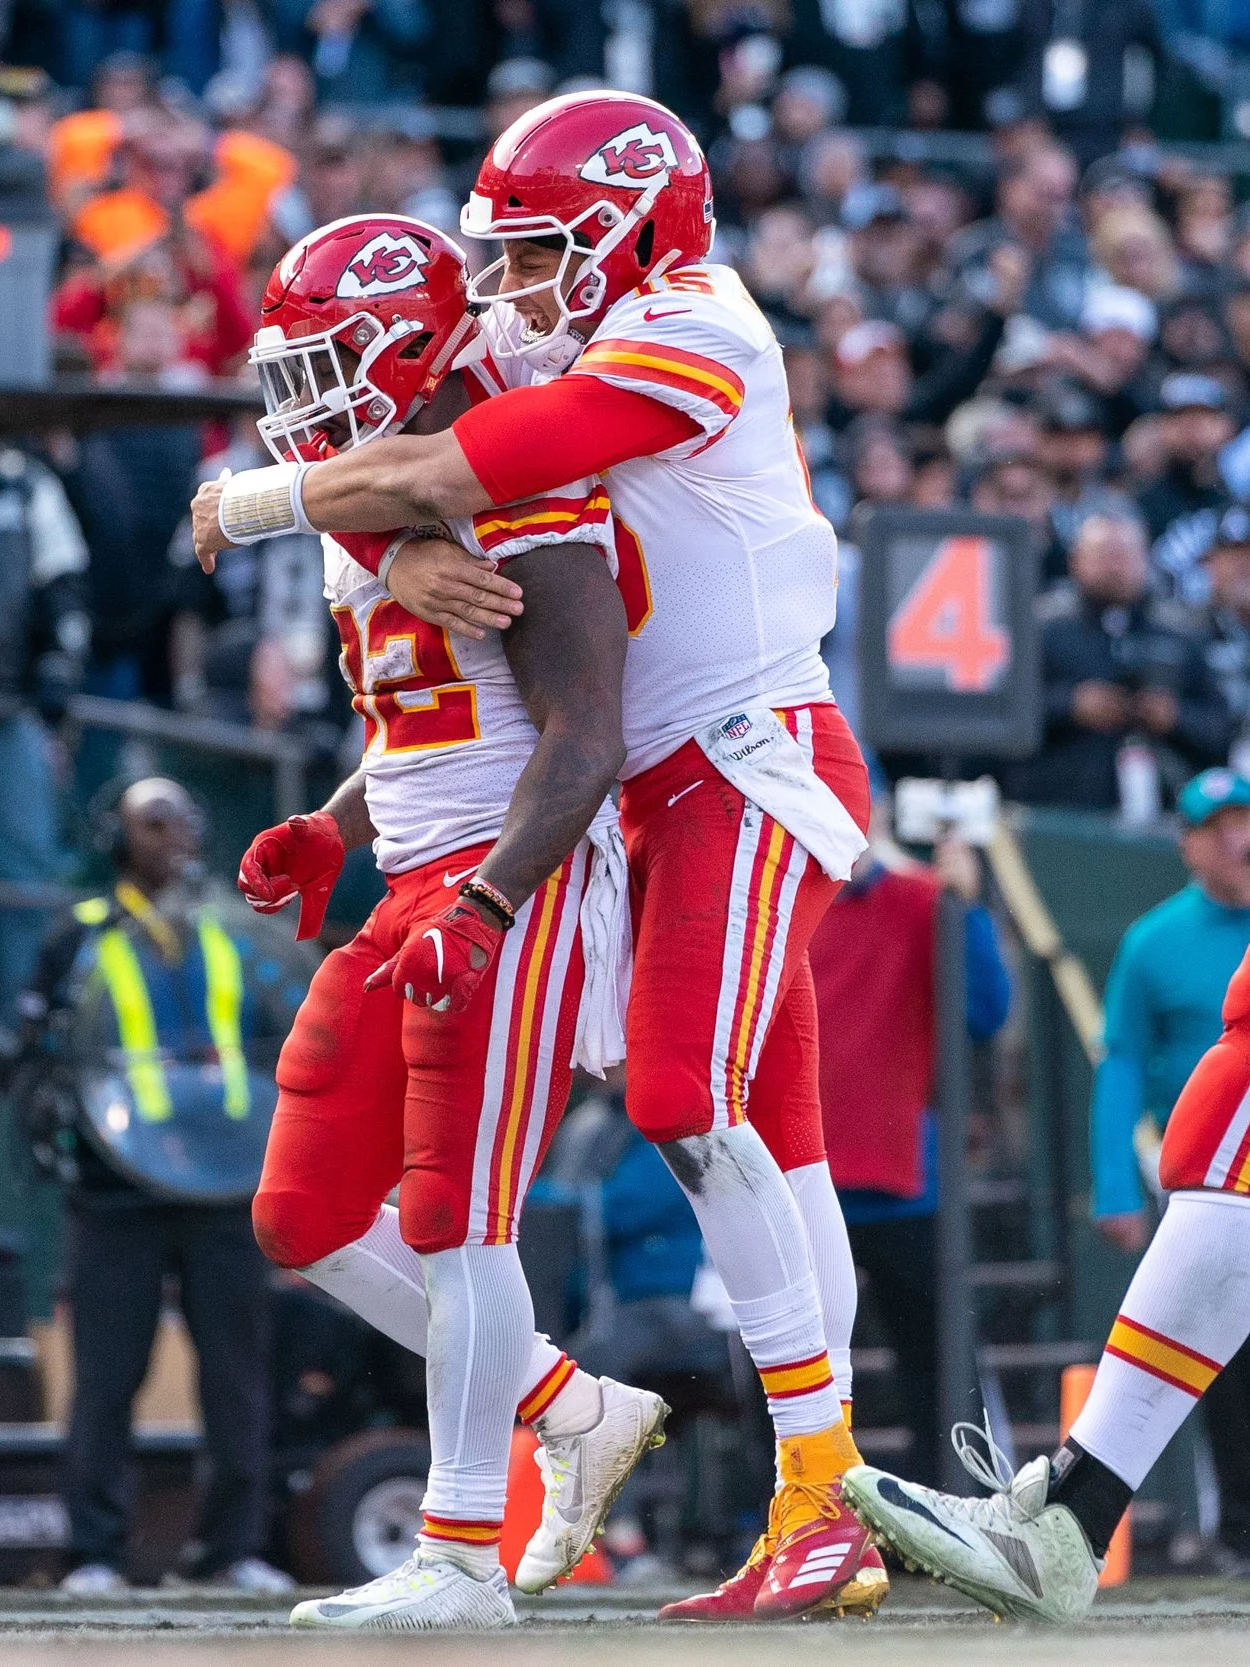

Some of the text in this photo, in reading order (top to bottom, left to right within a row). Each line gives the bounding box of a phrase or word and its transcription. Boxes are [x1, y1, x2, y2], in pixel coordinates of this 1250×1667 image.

[598, 138, 667, 179] KC
[348, 246, 418, 288] KC
[886, 533, 1011, 693] 4
[726, 721, 750, 739] NFL
[729, 738, 770, 761] Wilson
